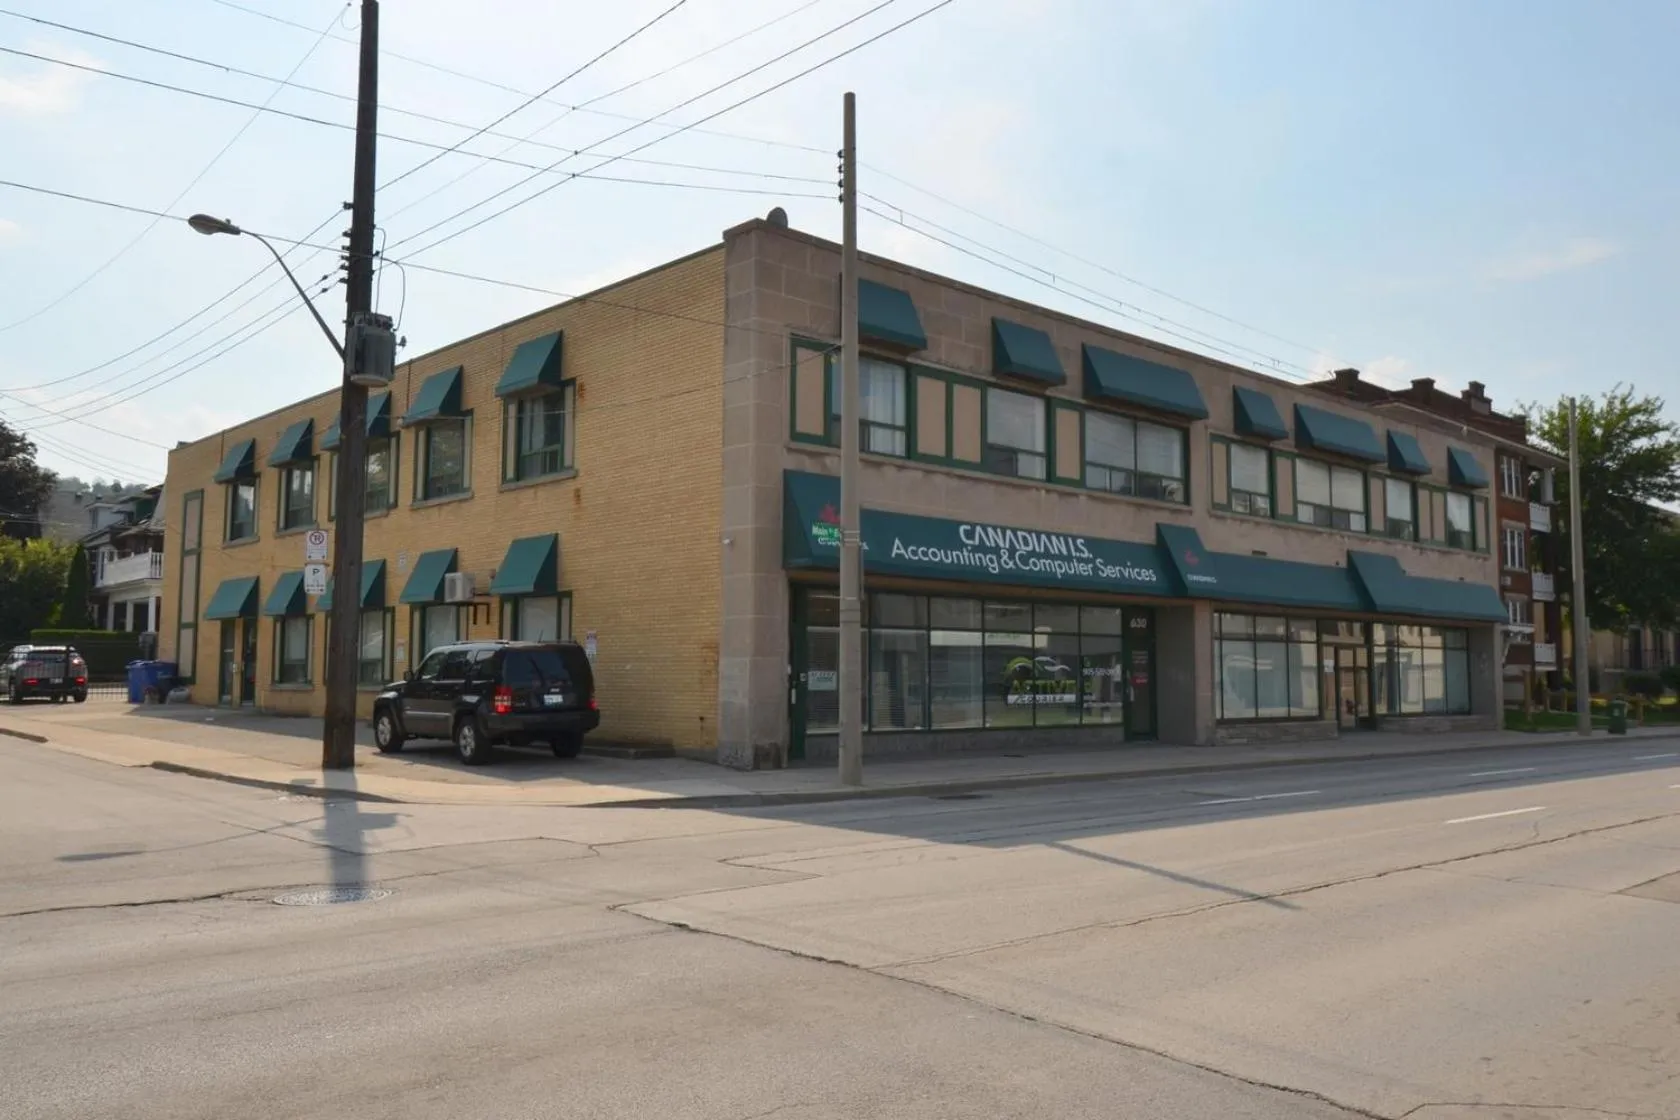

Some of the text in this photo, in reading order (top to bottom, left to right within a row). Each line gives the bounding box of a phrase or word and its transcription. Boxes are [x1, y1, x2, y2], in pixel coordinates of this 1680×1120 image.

[959, 524, 1066, 556] CANADIAN
[891, 537, 999, 574] Accounting
[1000, 550, 1016, 570] &
[1016, 550, 1094, 579] Computer
[1099, 558, 1157, 582] Services
